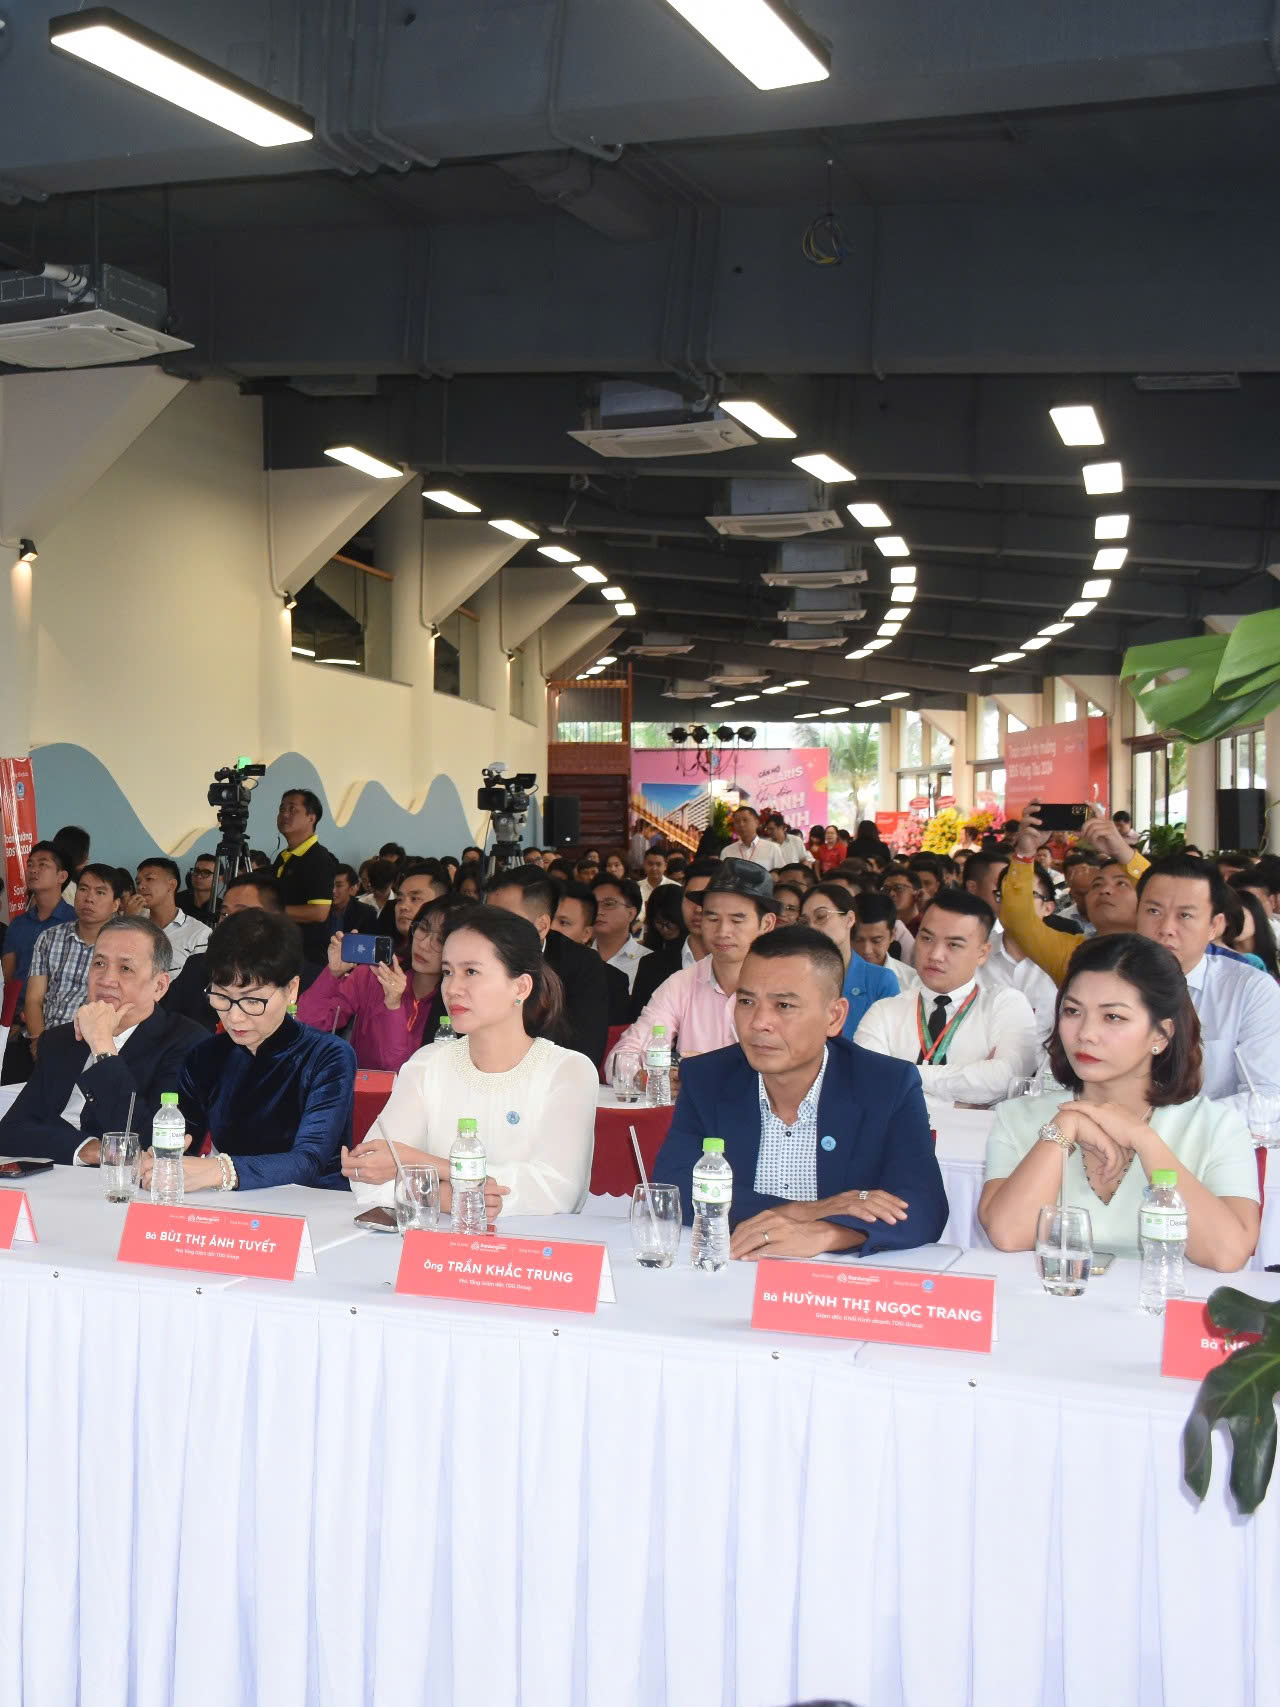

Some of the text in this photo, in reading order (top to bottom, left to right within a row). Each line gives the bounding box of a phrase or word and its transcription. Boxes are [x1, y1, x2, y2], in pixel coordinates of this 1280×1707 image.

[145, 1232, 156, 1240] Bà
[160, 1231, 180, 1242] BÙI
[186, 1234, 206, 1247] THỊ
[239, 1238, 276, 1253] TUYẾT
[424, 1259, 573, 1283] Ông TRẦN KHẮC TRUNG
[763, 1291, 983, 1322] Bà HUỲNH THỊ NGỌC TRANG
[1200, 1338, 1218, 1350] Bà
